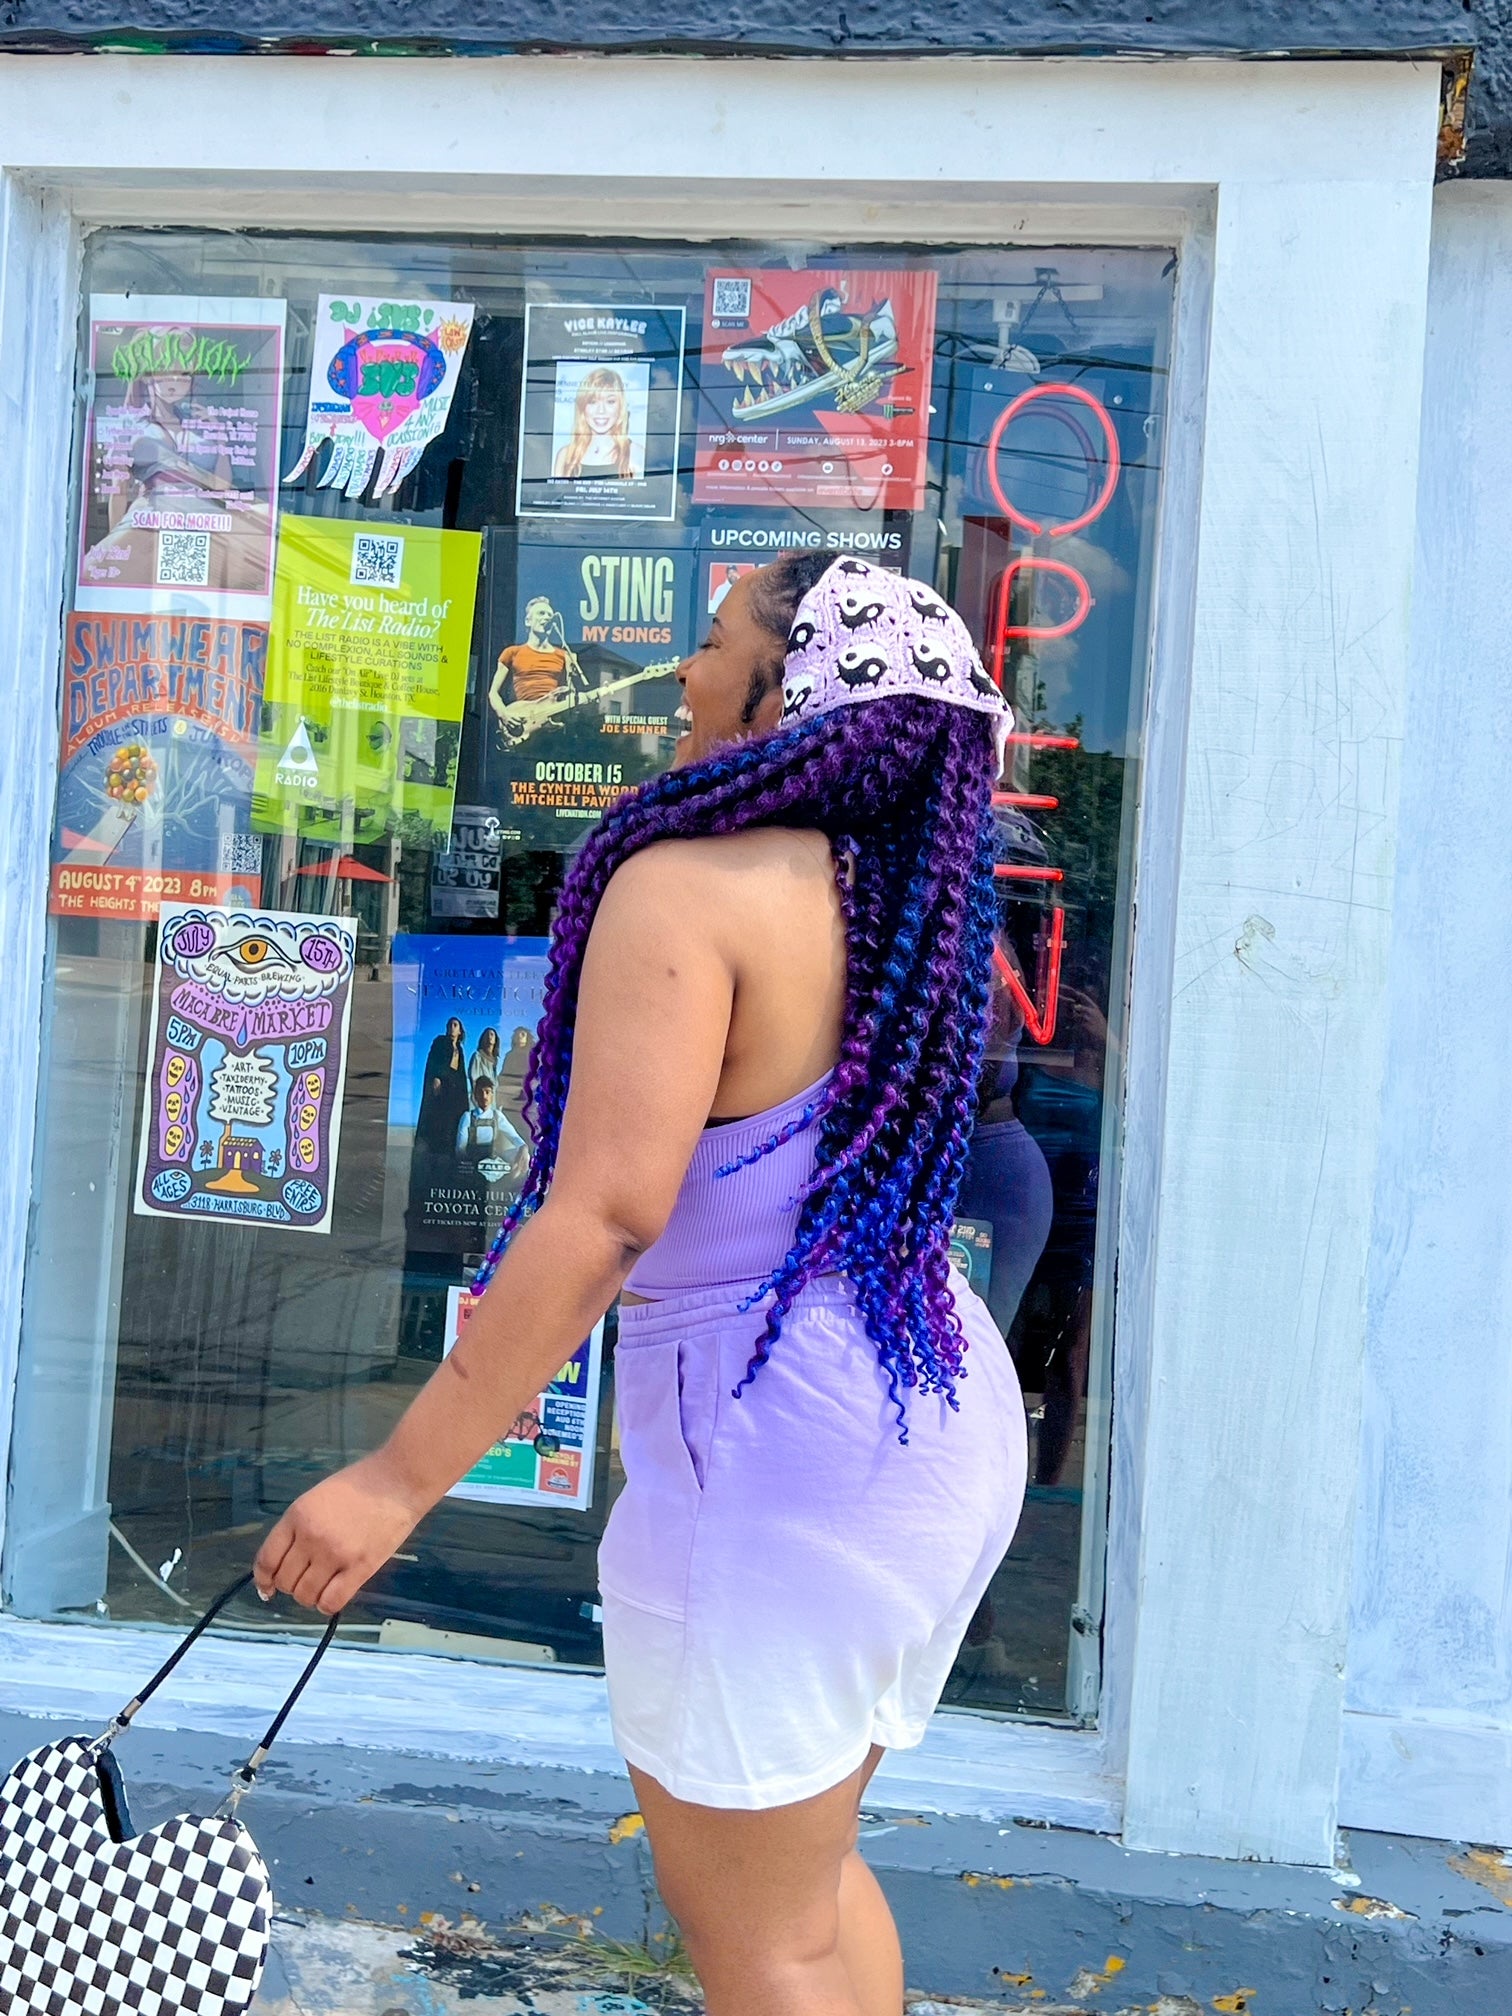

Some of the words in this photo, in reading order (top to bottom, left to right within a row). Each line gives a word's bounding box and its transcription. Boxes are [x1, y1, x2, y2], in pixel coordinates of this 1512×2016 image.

[597, 317, 648, 334] KAYLEE
[721, 320, 736, 328] SCAN
[736, 320, 745, 328] ME
[709, 434, 726, 446] nrg
[737, 433, 768, 445] center
[823, 436, 854, 446] AUGUST
[869, 438, 888, 447] 2023
[132, 511, 160, 529] SCAN
[162, 511, 184, 530] FOR
[711, 529, 822, 548] UPCOMING
[826, 532, 902, 550] SHOWS
[580, 555, 674, 623] STING
[296, 585, 339, 608] Have
[342, 594, 375, 614] you
[378, 593, 428, 617] heard
[431, 599, 453, 619] of
[306, 606, 340, 629] The
[341, 611, 375, 633] List
[378, 615, 441, 639] Radio?
[294, 630, 314, 641] THE
[315, 631, 337, 643] LIST
[338, 635, 370, 646] RADIO
[372, 638, 381, 647] IS
[393, 640, 415, 650] VIBE
[417, 642, 444, 653] WITH
[582, 626, 609, 642] MY
[611, 626, 672, 644] SONGS
[69, 619, 268, 690] SWIMWEAR
[286, 639, 301, 650] NO
[303, 640, 373, 657] COMPLEXION,
[375, 648, 395, 659] ALL
[397, 650, 439, 663] SOUNDS
[440, 655, 449, 664] &
[310, 651, 363, 665] LIFESTYLE
[364, 656, 423, 671] CURATIONS
[288, 671, 303, 682] The
[303, 673, 318, 683] List
[317, 674, 349, 687] Lifestyle
[349, 677, 383, 690] Boutique
[391, 680, 416, 692] Coffee
[308, 684, 328, 693] 2016
[68, 661, 264, 743] DEPARTMENT
[66, 711, 118, 756] ALBUM
[130, 702, 213, 727] RELEASE
[599, 723, 622, 734] JOE
[622, 724, 668, 735] SUMNER
[604, 714, 622, 725] WITH
[622, 715, 647, 725] SPECIAL
[648, 716, 669, 726] GUEST
[275, 773, 318, 788] RADIO
[535, 761, 603, 783] OCTOBER
[607, 764, 623, 784] 15
[510, 781, 536, 793] THE
[539, 783, 596, 796] CYNTHIA
[513, 793, 578, 807] MITCHELL
[58, 870, 121, 891] AUGUST
[142, 876, 181, 895] 2023
[58, 893, 84, 909] THE
[90, 895, 135, 912] HEIGHTS
[177, 926, 210, 953] JULY
[305, 938, 338, 969] 15TH
[206, 963, 232, 983] EQUAL
[233, 975, 259, 986] PARTS
[260, 971, 302, 983] BREWING
[434, 968, 476, 979] GRETA
[172, 988, 240, 1032] MACABRE
[251, 1001, 331, 1035] MARKET
[168, 1018, 198, 1047] 5PM
[290, 1040, 325, 1065] 10PM
[234, 1062, 252, 1073] ART
[222, 1073, 266, 1086] TAXIDERMY
[225, 1084, 260, 1097] TATTOOS
[222, 1104, 260, 1117] VINTAGE
[227, 1096, 257, 1107] MUSIC
[477, 1163, 512, 1172] KALEO
[152, 1173, 170, 1193] ALL
[160, 1180, 188, 1200] AGES
[290, 1180, 320, 1204] FREE
[191, 1196, 211, 1210] 3118
[213, 1199, 263, 1216] HARRISBURG
[284, 1188, 318, 1212] ENTRY
[430, 1188, 482, 1201] FRIDAY,
[483, 1190, 516, 1204] JULY
[424, 1201, 480, 1215] TOYOTA
